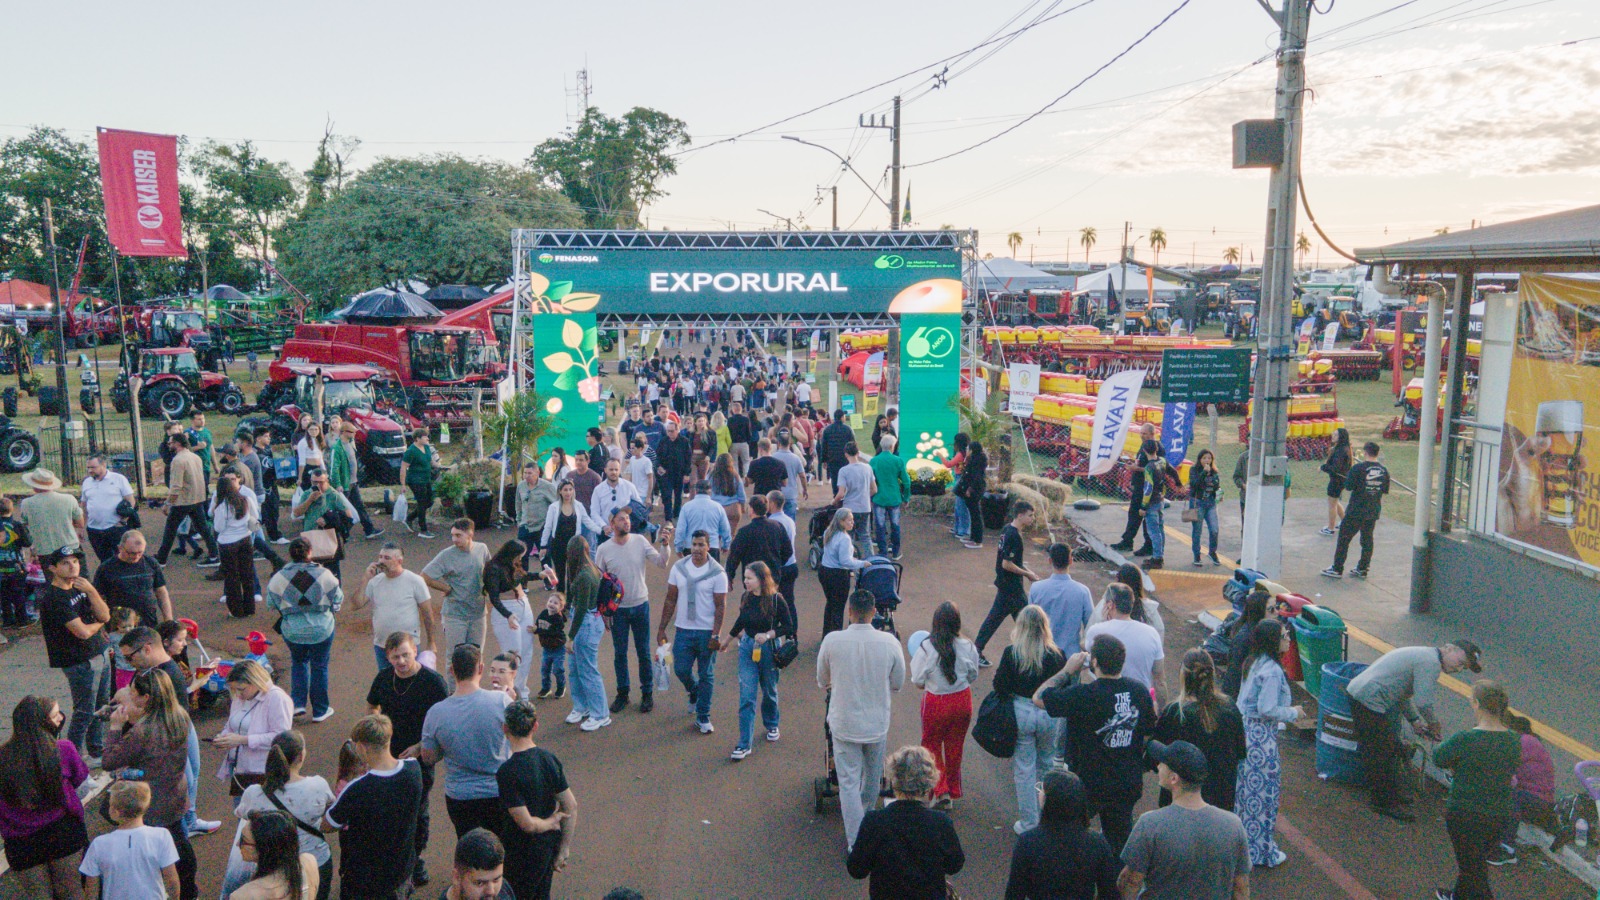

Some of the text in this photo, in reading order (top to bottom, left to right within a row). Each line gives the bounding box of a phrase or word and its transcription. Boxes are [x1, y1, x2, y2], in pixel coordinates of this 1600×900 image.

[132, 149, 160, 204] KAISER
[554, 254, 599, 263] FENASOJA
[649, 271, 848, 292] EXPORURAL
[906, 326, 954, 358] 60
[931, 334, 946, 350] ANOS
[1097, 385, 1130, 460] HAVAN
[1170, 402, 1188, 453] HAVA
[1114, 692, 1131, 703] THE
[1114, 702, 1131, 713] GIRL
